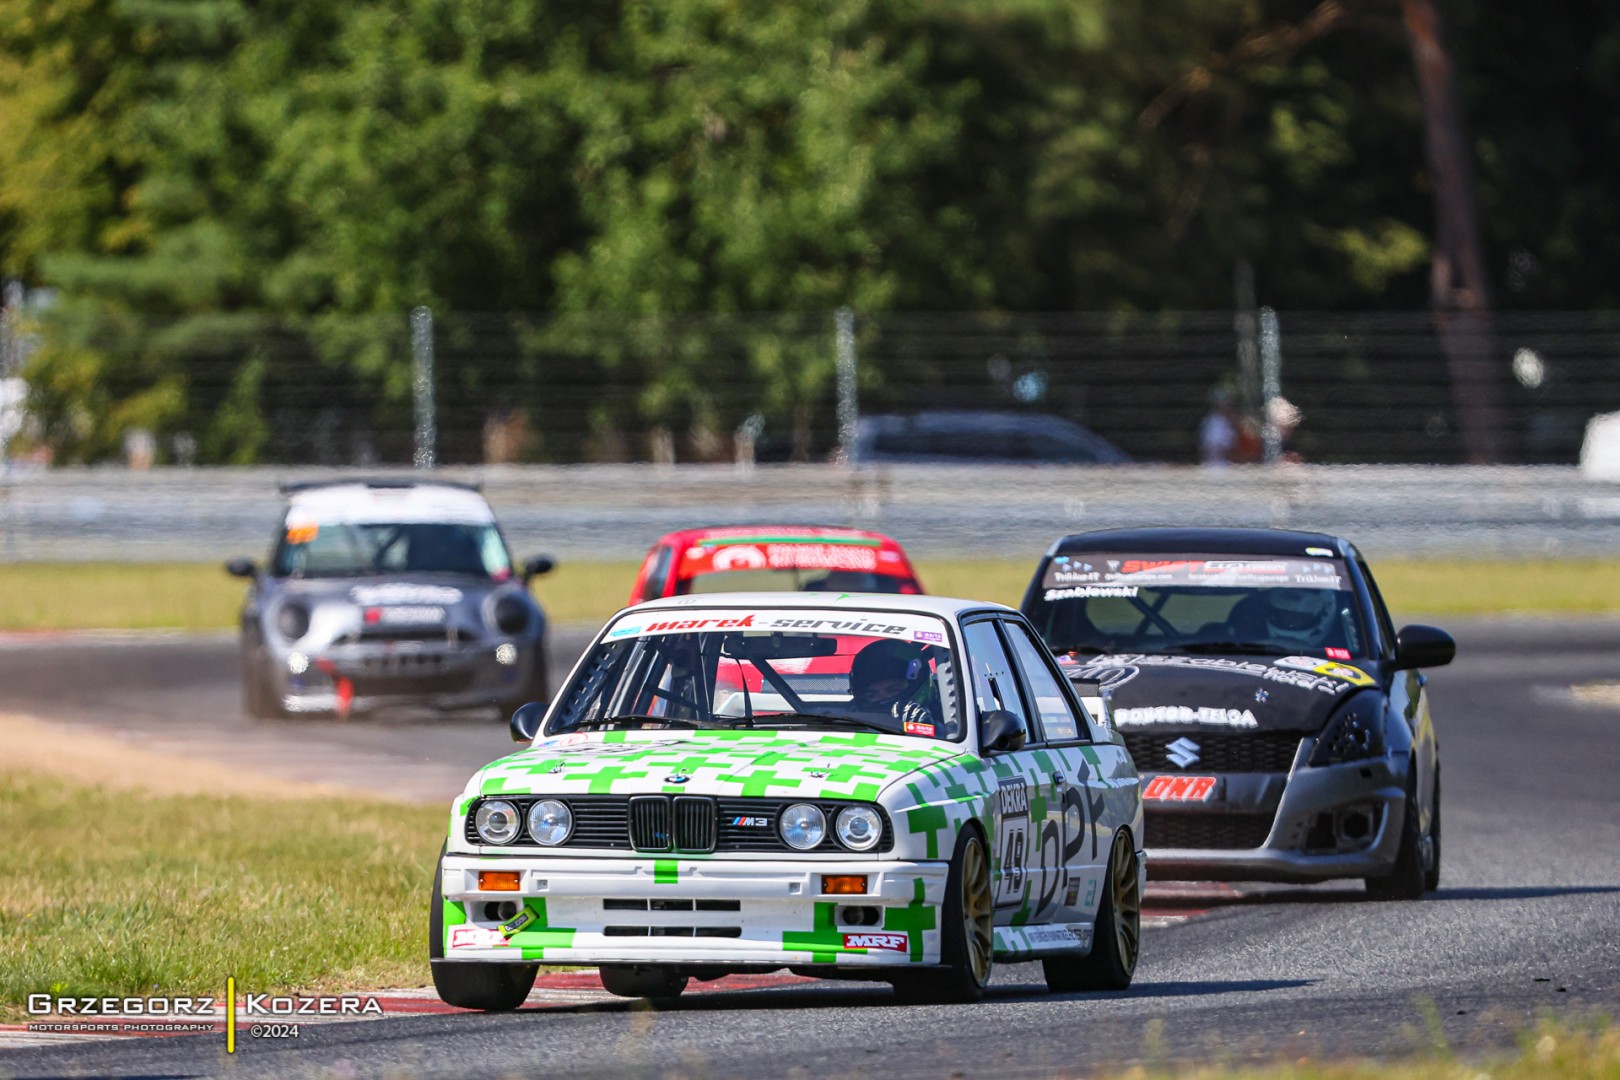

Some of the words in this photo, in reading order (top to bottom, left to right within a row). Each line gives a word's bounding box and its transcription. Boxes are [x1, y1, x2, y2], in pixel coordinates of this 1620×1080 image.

[1001, 782, 1027, 815] DEKRA
[743, 816, 768, 827] M3
[1003, 828, 1024, 894] 49
[846, 934, 905, 949] MRF
